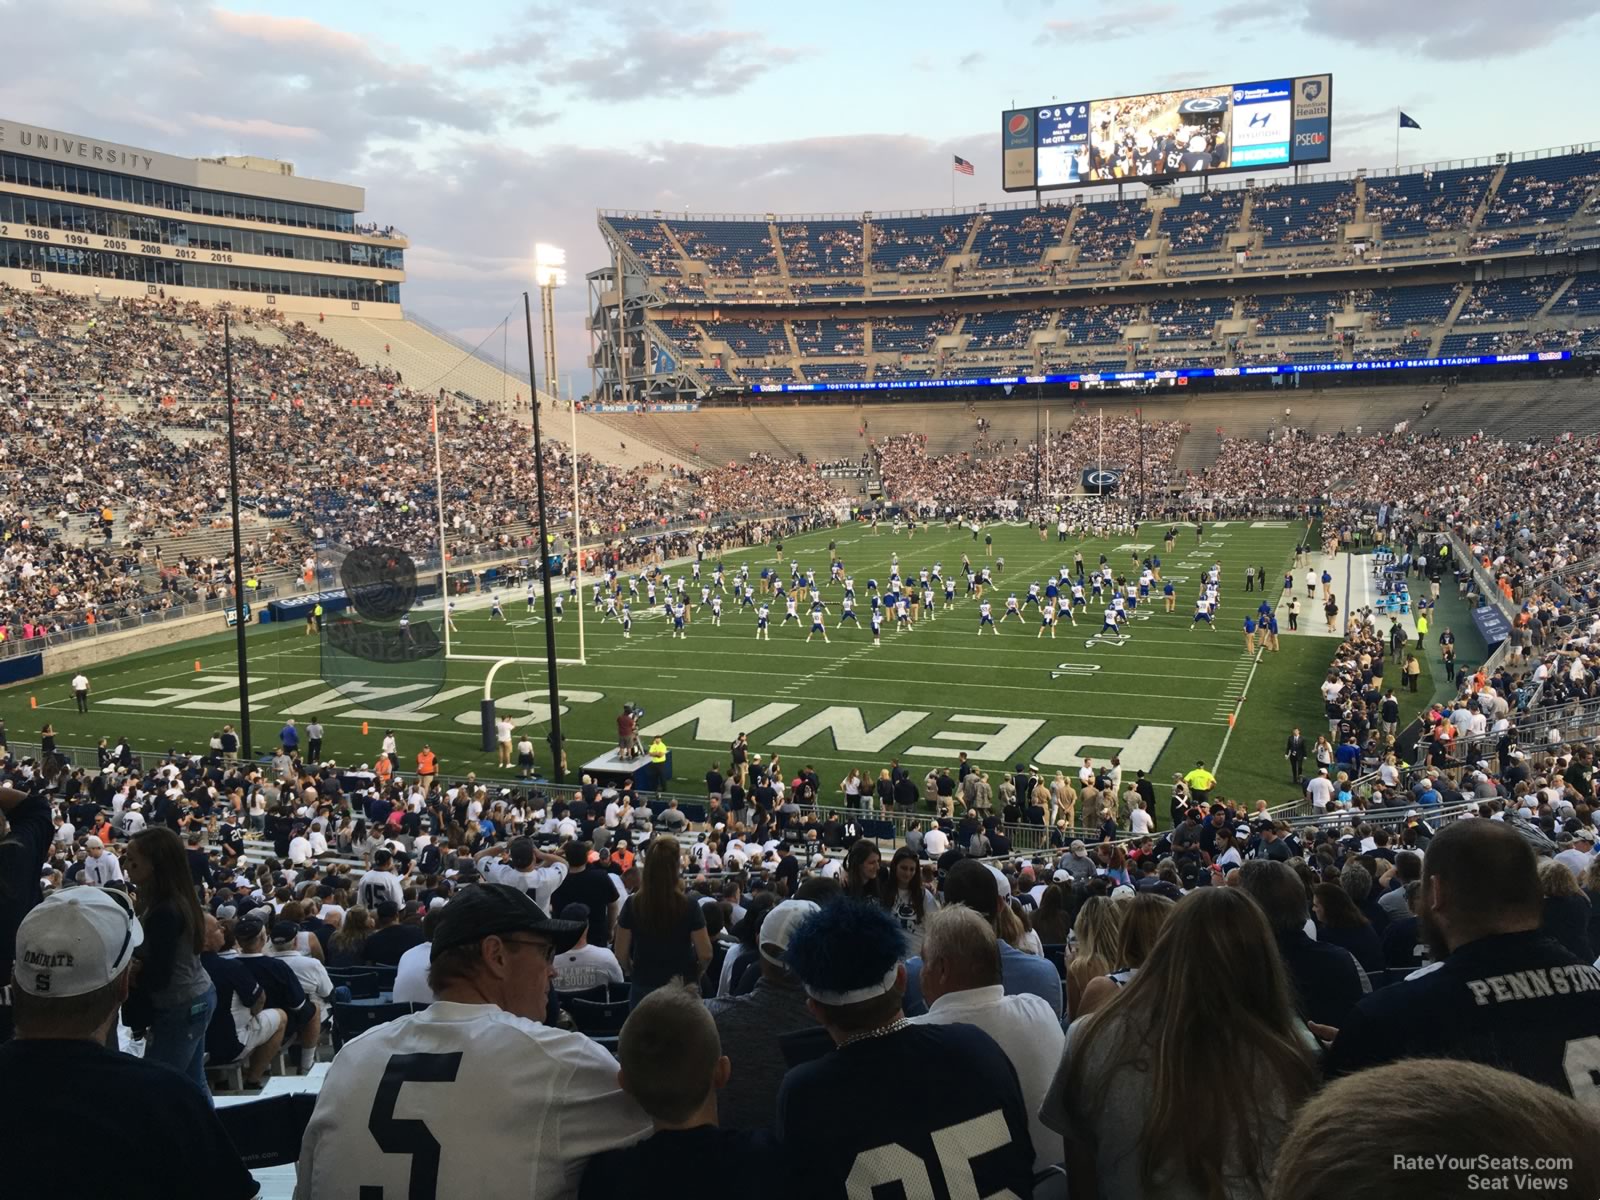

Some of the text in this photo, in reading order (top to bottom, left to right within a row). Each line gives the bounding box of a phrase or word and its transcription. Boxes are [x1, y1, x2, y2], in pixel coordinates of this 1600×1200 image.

[1296, 106, 1327, 117] Health
[1295, 132, 1323, 147] PSECU
[20, 129, 153, 171] UNIVERSITY
[24, 228, 50, 241] 1986
[65, 234, 89, 246] 1994
[103, 239, 127, 251] 2005
[141, 244, 162, 255] 2008
[175, 248, 197, 260] 2012
[210, 253, 233, 263] 2016
[1293, 364, 1331, 372] TOSTITOS
[1407, 359, 1441, 367] BEAVER
[1442, 357, 1481, 365] STADIUM!
[1050, 662, 1102, 680] 10
[95, 676, 605, 727] STATE
[637, 697, 1177, 775] PENN
[1507, 744, 1517, 754] 17
[230, 827, 243, 842] 20
[844, 823, 856, 837] 14
[421, 851, 429, 864] 1
[692, 847, 703, 860] 14
[35, 973, 50, 991] S
[1465, 964, 1600, 1006] PENN STAT
[359, 1051, 464, 1200] 5
